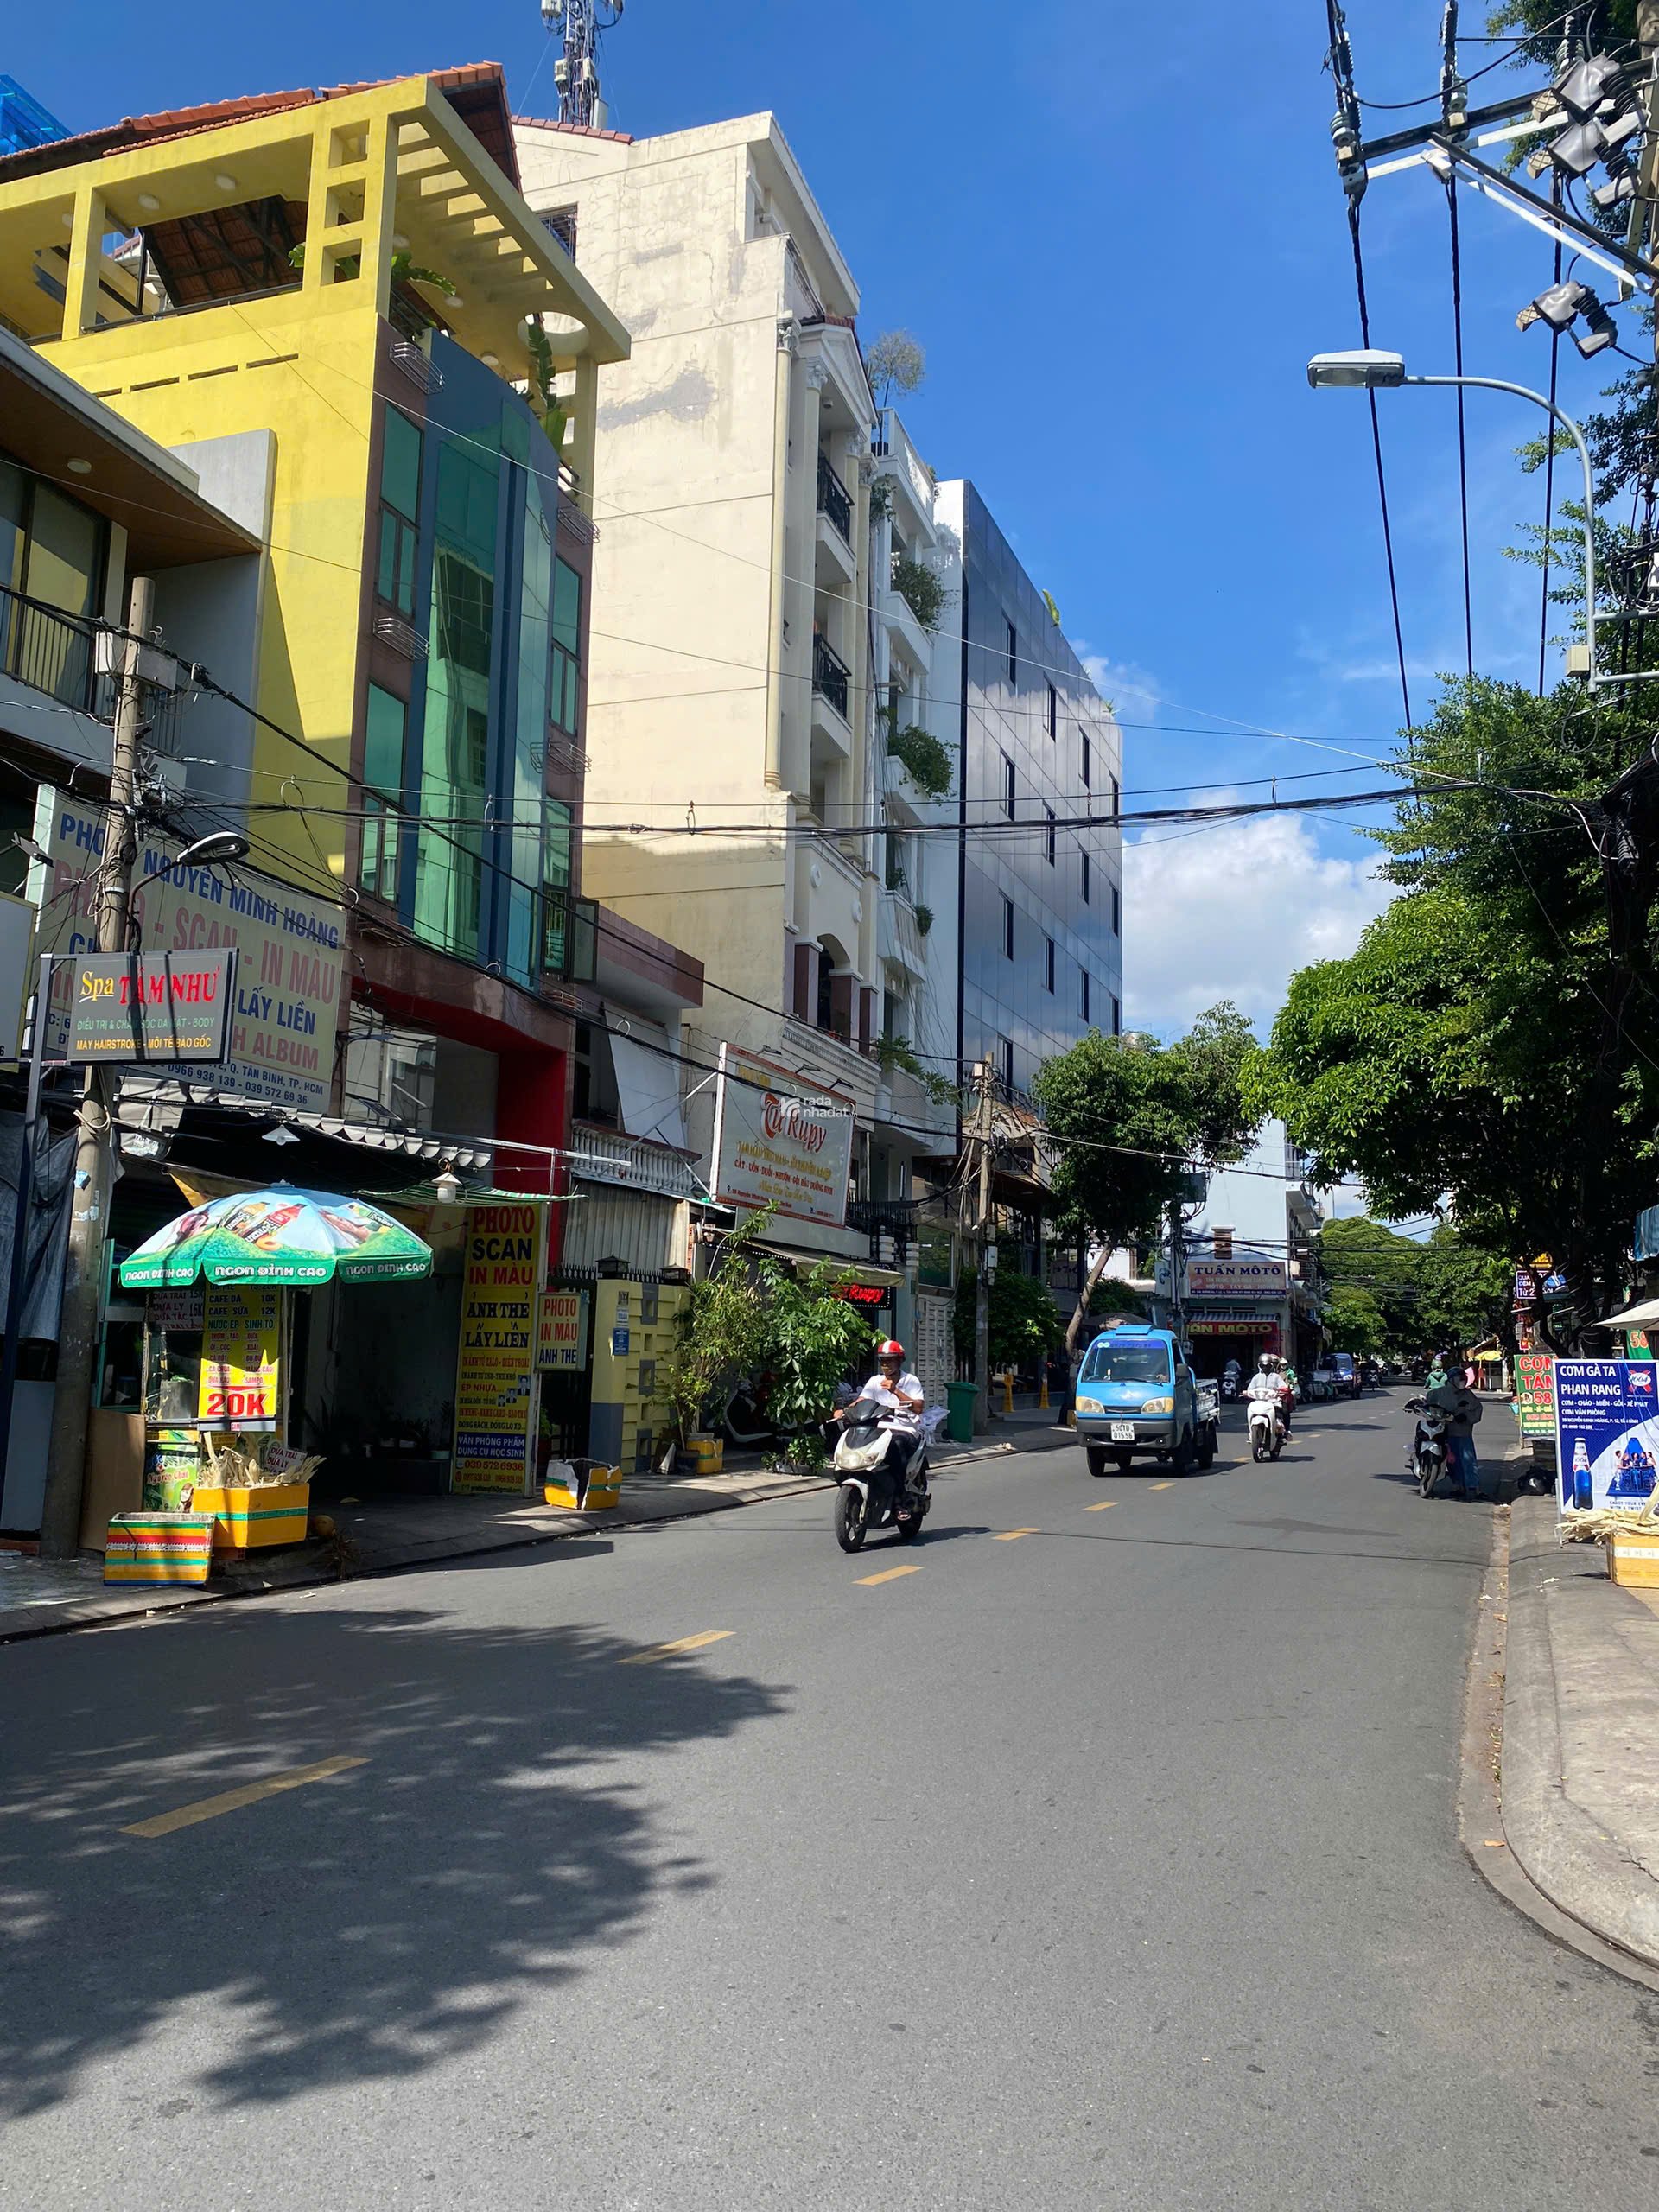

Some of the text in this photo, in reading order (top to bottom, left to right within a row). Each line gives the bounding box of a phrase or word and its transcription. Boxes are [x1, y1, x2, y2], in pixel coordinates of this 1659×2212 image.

[230, 887, 278, 926] MINH
[283, 908, 339, 949] HOÀNG
[261, 940, 283, 988] IN
[289, 948, 335, 1004] MÀU
[79, 971, 114, 1001] Spa
[171, 965, 221, 1003] NHƯ
[238, 987, 316, 1035] LẤY LIỀN
[96, 1020, 107, 1031] TRỊ
[109, 1020, 114, 1029] &
[158, 1019, 168, 1028] DA
[193, 1017, 215, 1027] BODY
[94, 1039, 141, 1050] HAIRSTROKE
[194, 1034, 212, 1047] GỐC
[252, 1032, 319, 1071] ALBUM
[168, 1065, 308, 1104] 0966 938 139 039 572 69 36
[231, 1065, 238, 1074] Q.
[243, 1066, 259, 1079] TÂN
[289, 1077, 302, 1089] TP.
[304, 1084, 323, 1096] HCM
[788, 1107, 828, 1154] Rupy
[472, 1205, 535, 1234] PHOTO
[472, 1238, 532, 1261] SCAN
[214, 1266, 255, 1276] NGON
[297, 1267, 327, 1277] CAO
[405, 1263, 426, 1272] CAO
[469, 1262, 533, 1286] IN MÀU
[1195, 1263, 1281, 1275] TUẤN MÔTÔ
[262, 1306, 276, 1315] 12K
[467, 1291, 530, 1319] ẢNH THẺ
[543, 1298, 576, 1317] PHOTO
[245, 1320, 263, 1329] SINH
[465, 1321, 530, 1348] LẤY LIỀN
[540, 1319, 577, 1342] IN MÀU
[539, 1343, 577, 1364] ẢNH THẺ
[1560, 1363, 1616, 1376] CƠM GÀ TA
[1560, 1384, 1621, 1395] PHAN RANG
[207, 1393, 266, 1416] 20K
[458, 1434, 525, 1447] VĂN PHÒNG PHẨM
[457, 1447, 525, 1458] DỤNG CỤ HỌC SINH
[464, 1460, 524, 1471] 039 572 6936
